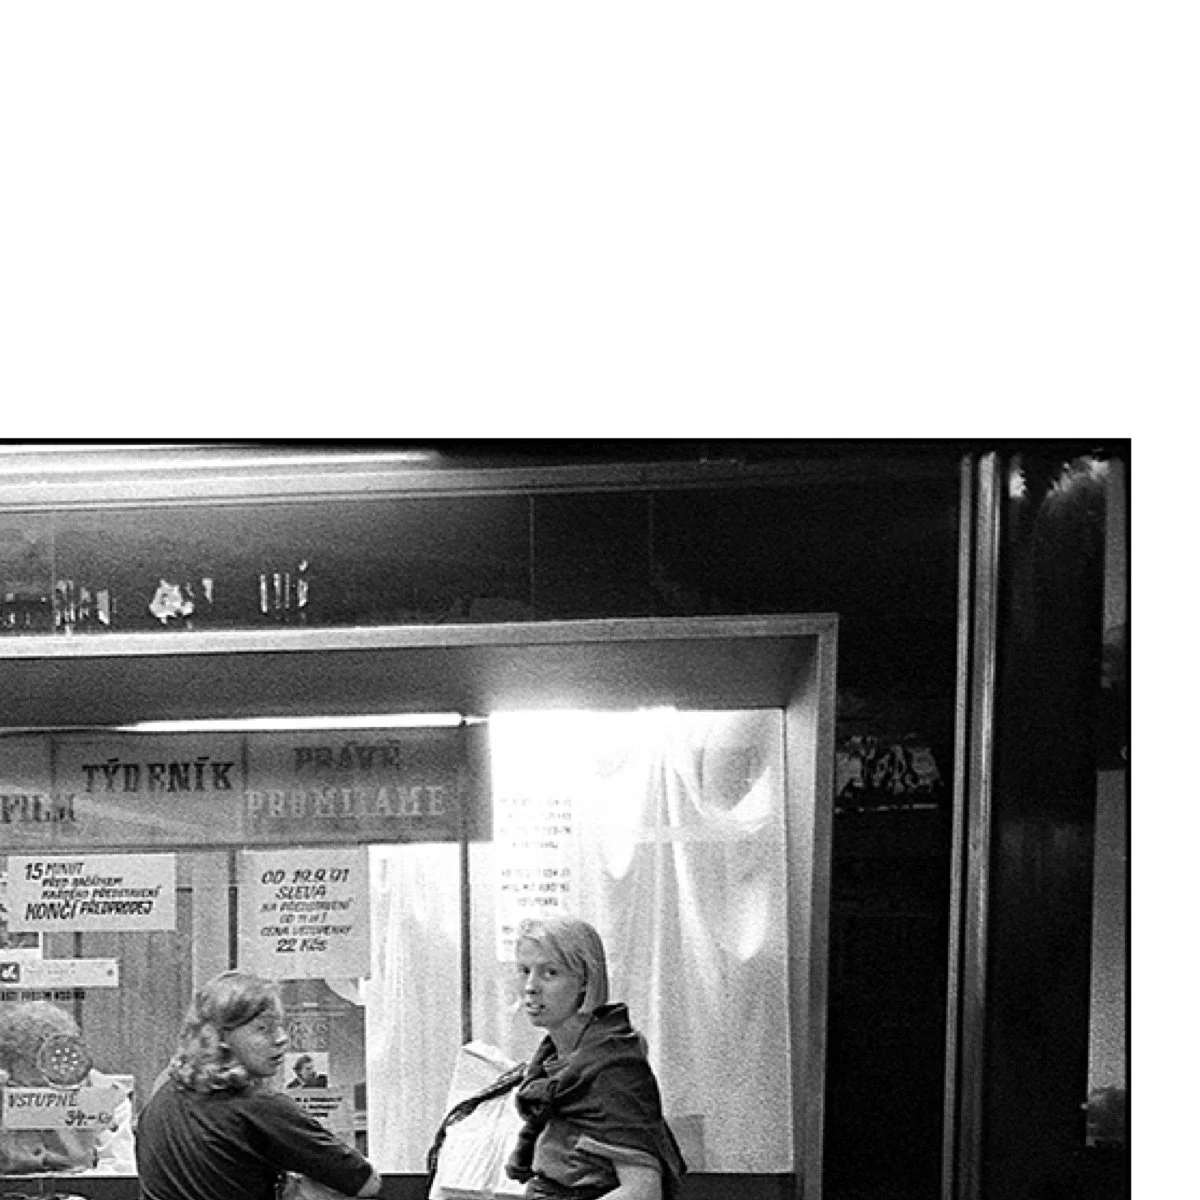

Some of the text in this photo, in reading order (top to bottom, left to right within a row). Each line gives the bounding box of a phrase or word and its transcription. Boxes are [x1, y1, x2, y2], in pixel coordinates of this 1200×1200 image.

[0, 793, 76, 824] FILM
[25, 862, 84, 880] 15 MINUT
[261, 869, 286, 884] OD
[275, 885, 327, 899] SLEVA
[25, 899, 153, 919] KONČÍ PŘEDPRODEJ
[276, 938, 297, 952] 22
